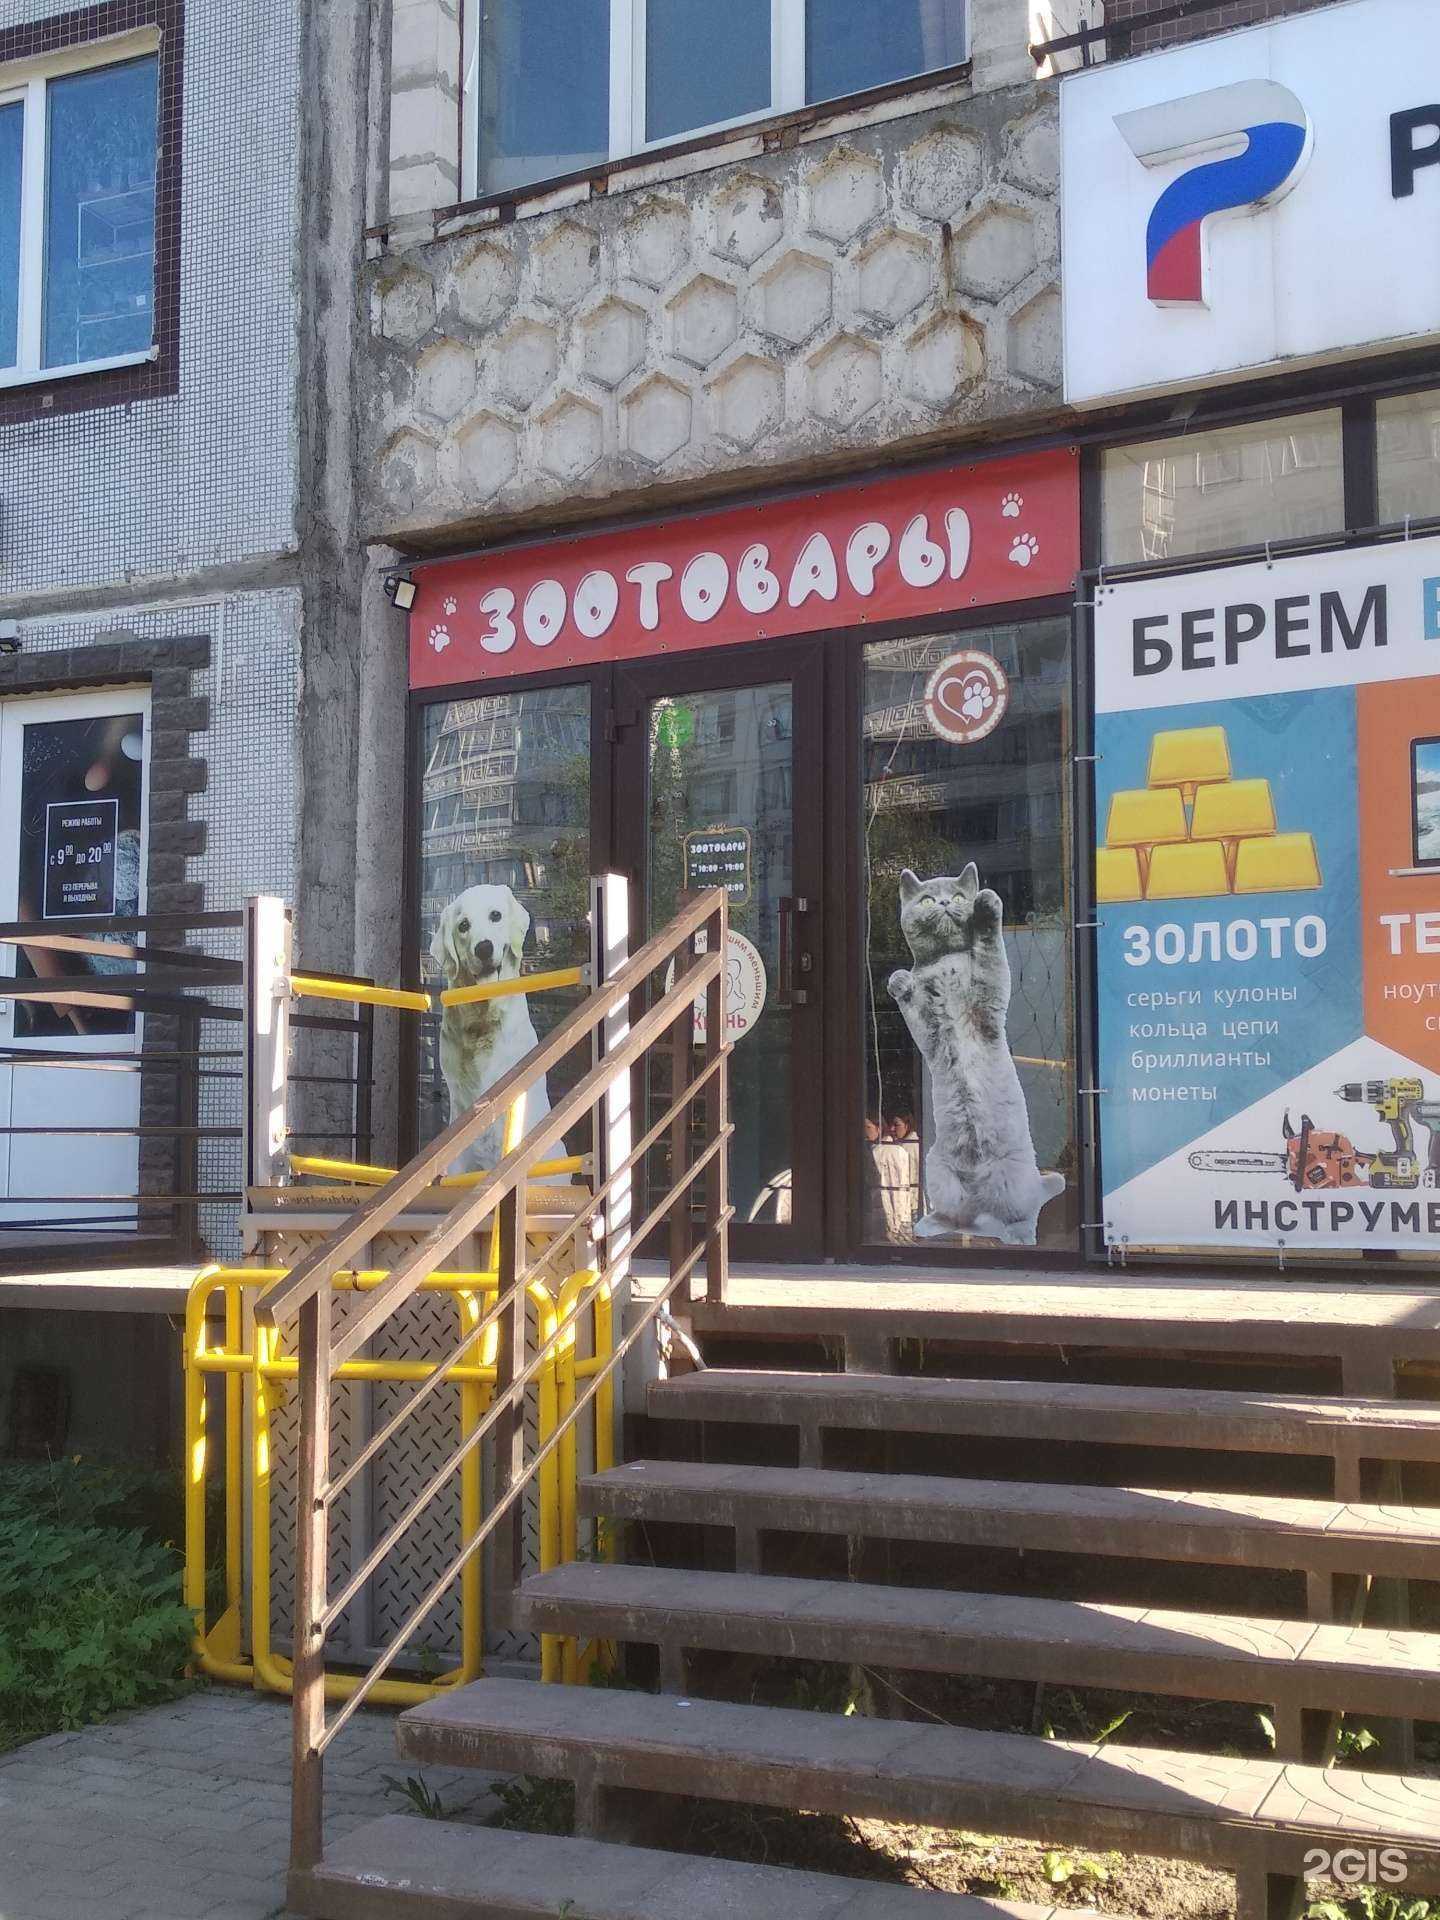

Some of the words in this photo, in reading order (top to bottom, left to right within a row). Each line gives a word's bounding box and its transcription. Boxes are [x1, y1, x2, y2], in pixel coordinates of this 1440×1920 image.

[479, 507, 970, 653] ЗООТОВАРЫ
[1132, 584, 1388, 677] БЕРЕМ
[62, 819, 80, 828] РЕЖИМ
[81, 817, 102, 827] РАБОТЫ
[1123, 915, 1327, 966] ЗОЛОТО
[1379, 912, 1440, 955] ТЕ
[1127, 989, 1200, 1010] серьги
[1213, 986, 1297, 1007] кулоны
[1383, 983, 1440, 1004] ноут
[1130, 1023, 1207, 1041] кольца
[1222, 1019, 1279, 1037] цепи
[1131, 1050, 1271, 1073] бриллианты
[1132, 1085, 1217, 1101] монеты
[1214, 1200, 1440, 1233] ИНСТРУМЕ
